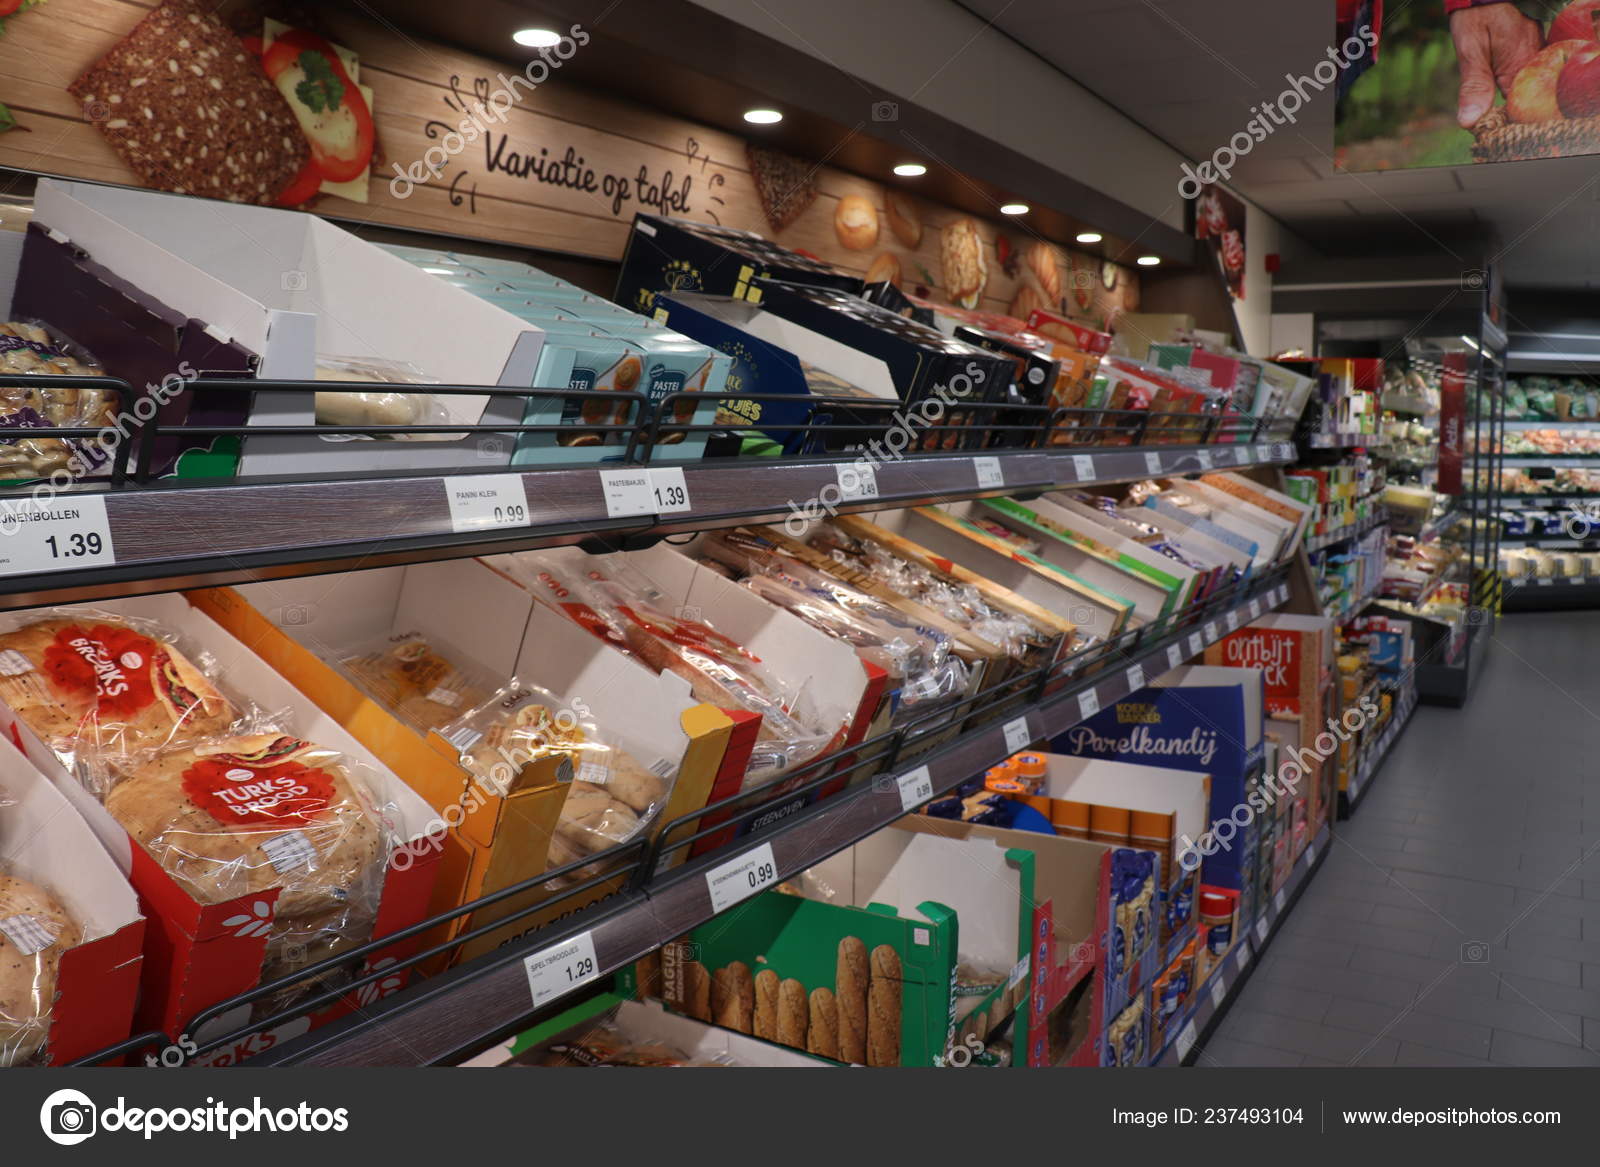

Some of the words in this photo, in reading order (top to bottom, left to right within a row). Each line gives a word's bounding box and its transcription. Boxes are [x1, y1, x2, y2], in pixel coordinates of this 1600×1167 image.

[486, 131, 598, 192] Variatie
[603, 174, 632, 215] op
[635, 165, 692, 217] tafel
[655, 486, 685, 506] 1.39
[494, 505, 524, 522] 0.99
[45, 532, 103, 558] 1.39
[1069, 726, 1217, 765] Parelkandij
[212, 777, 296, 804] TURKS
[228, 785, 309, 816] BROOD
[748, 863, 773, 888] 0.99
[566, 958, 593, 982] 1.29
